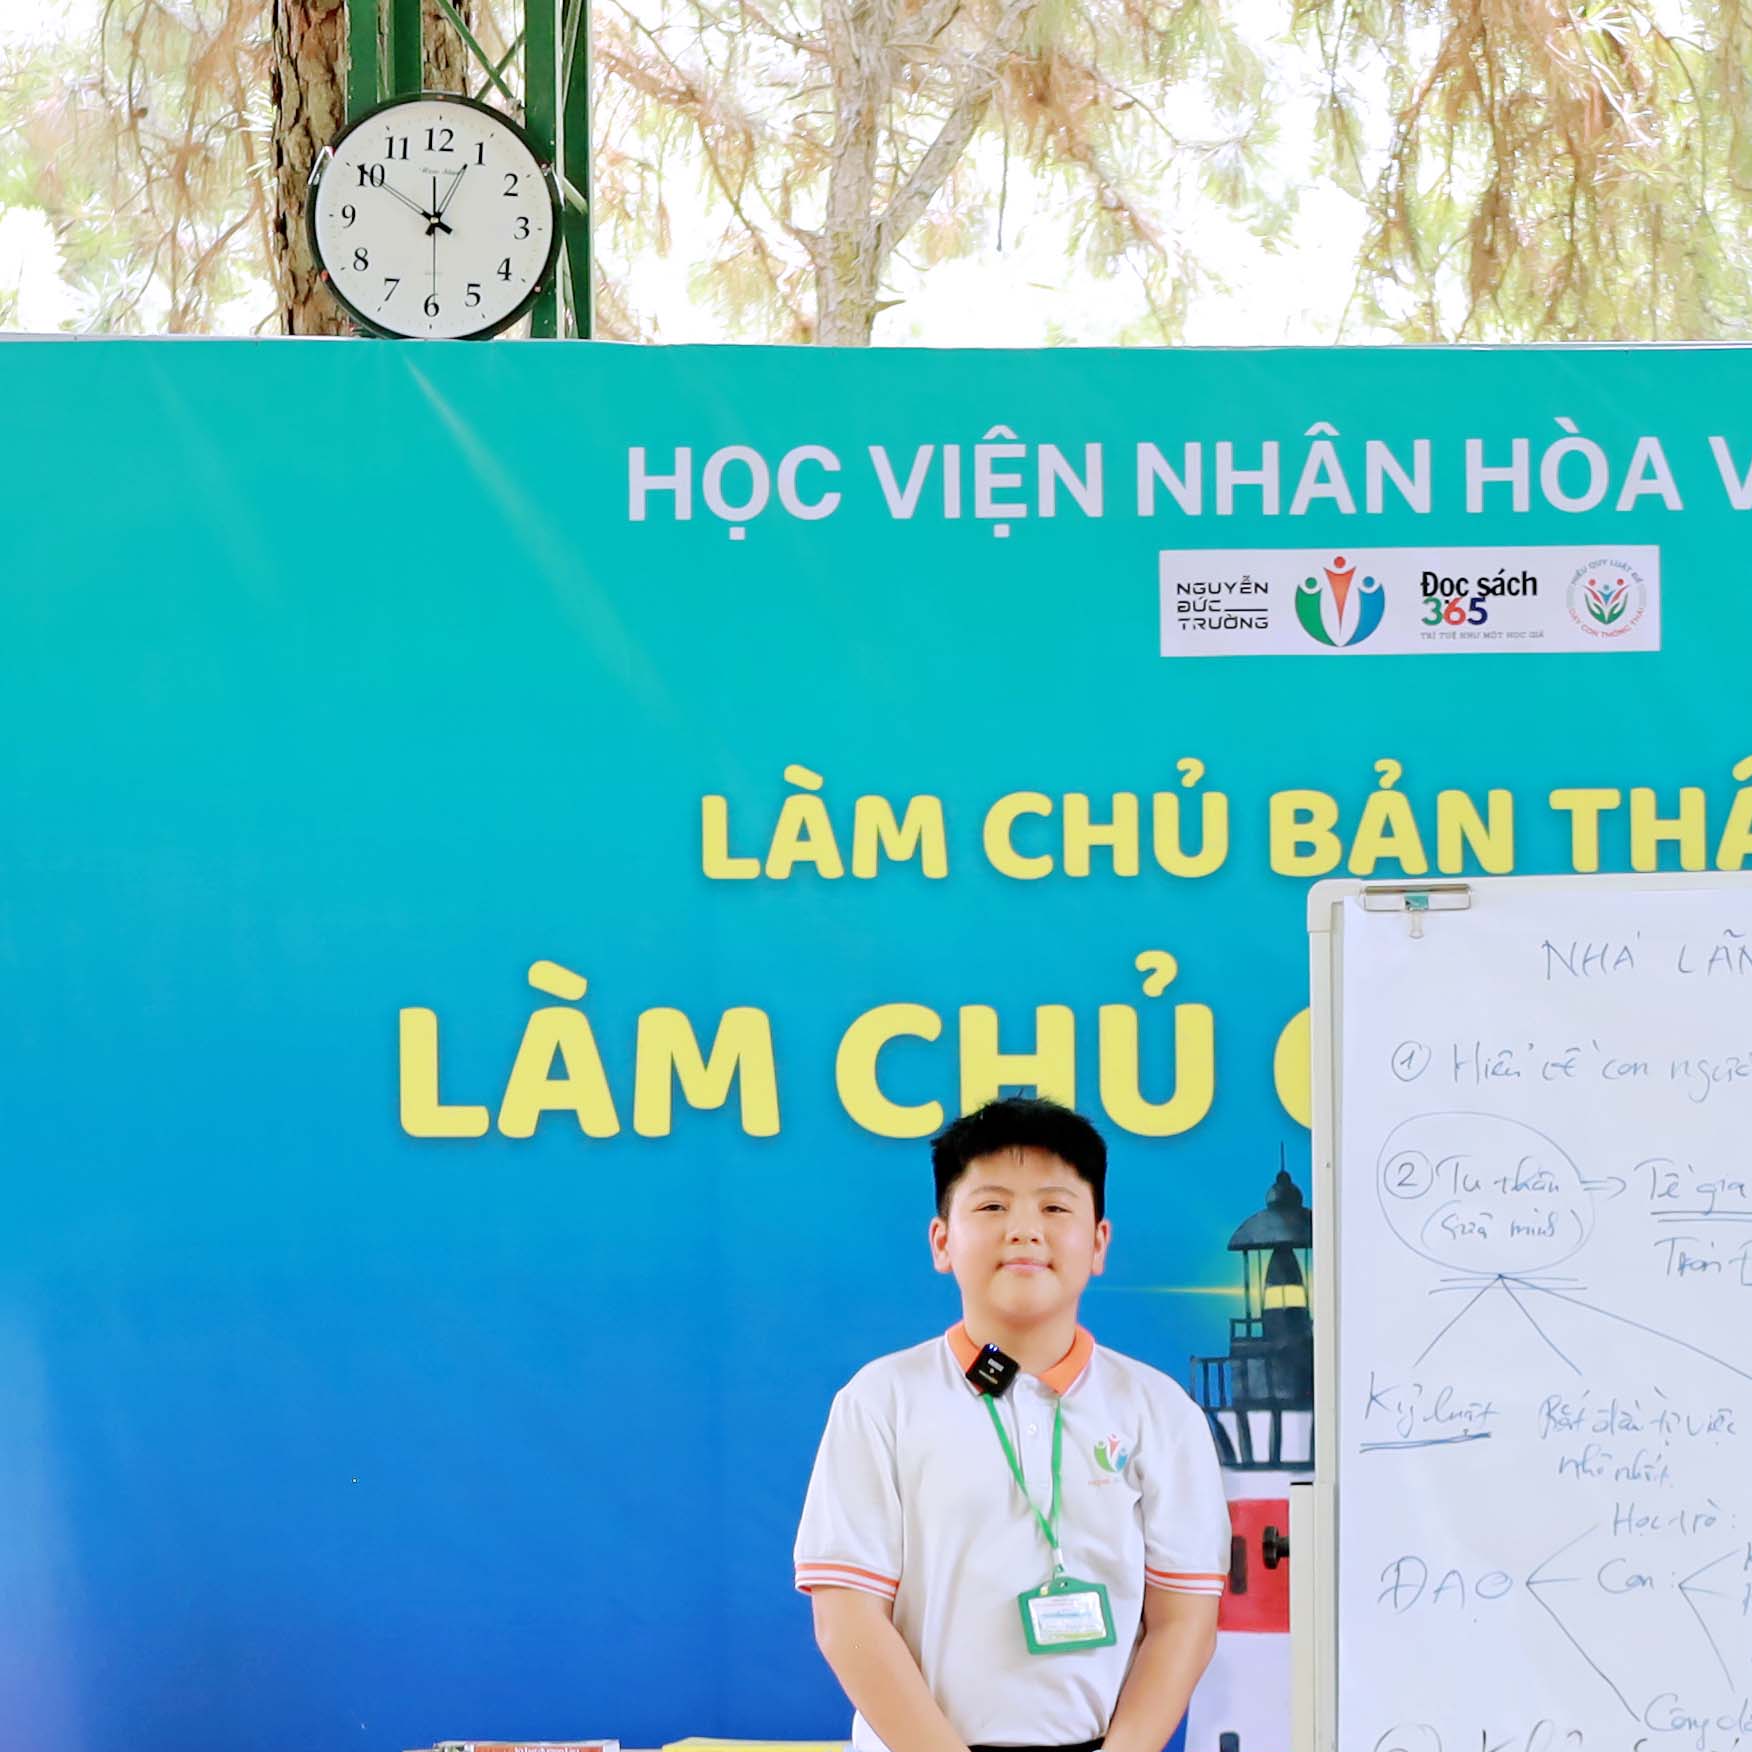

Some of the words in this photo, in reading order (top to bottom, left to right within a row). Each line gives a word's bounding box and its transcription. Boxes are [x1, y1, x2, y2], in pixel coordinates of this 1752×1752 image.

[385, 135, 410, 160] 11
[424, 128, 455, 152] 12
[474, 141, 486, 166] 1
[356, 163, 386, 187] 10
[503, 173, 519, 197] 2
[341, 204, 357, 229] 9
[513, 216, 530, 241] 3
[353, 247, 370, 272] 8
[497, 257, 512, 281] 4
[384, 278, 400, 302] 7
[464, 283, 482, 307] 5
[423, 293, 440, 318] 6
[628, 444, 842, 540] HỌC
[869, 425, 1103, 538] VIỆN
[1137, 421, 1431, 517] NHÂN
[1466, 416, 1684, 514] HÒA
[1177, 575, 1268, 595] NGUYỄN
[1420, 571, 1470, 604] Đọc
[1477, 568, 1538, 598] sách
[1177, 593, 1221, 613] ĐỨC
[1422, 597, 1488, 626] 365
[1178, 612, 1269, 631] TRƯỜNG
[700, 764, 948, 881] LÀM
[983, 757, 1230, 878] CHỦ
[1270, 757, 1516, 875] BẢN
[399, 959, 781, 1139] LÀM
[835, 949, 1215, 1139] CHỦ
